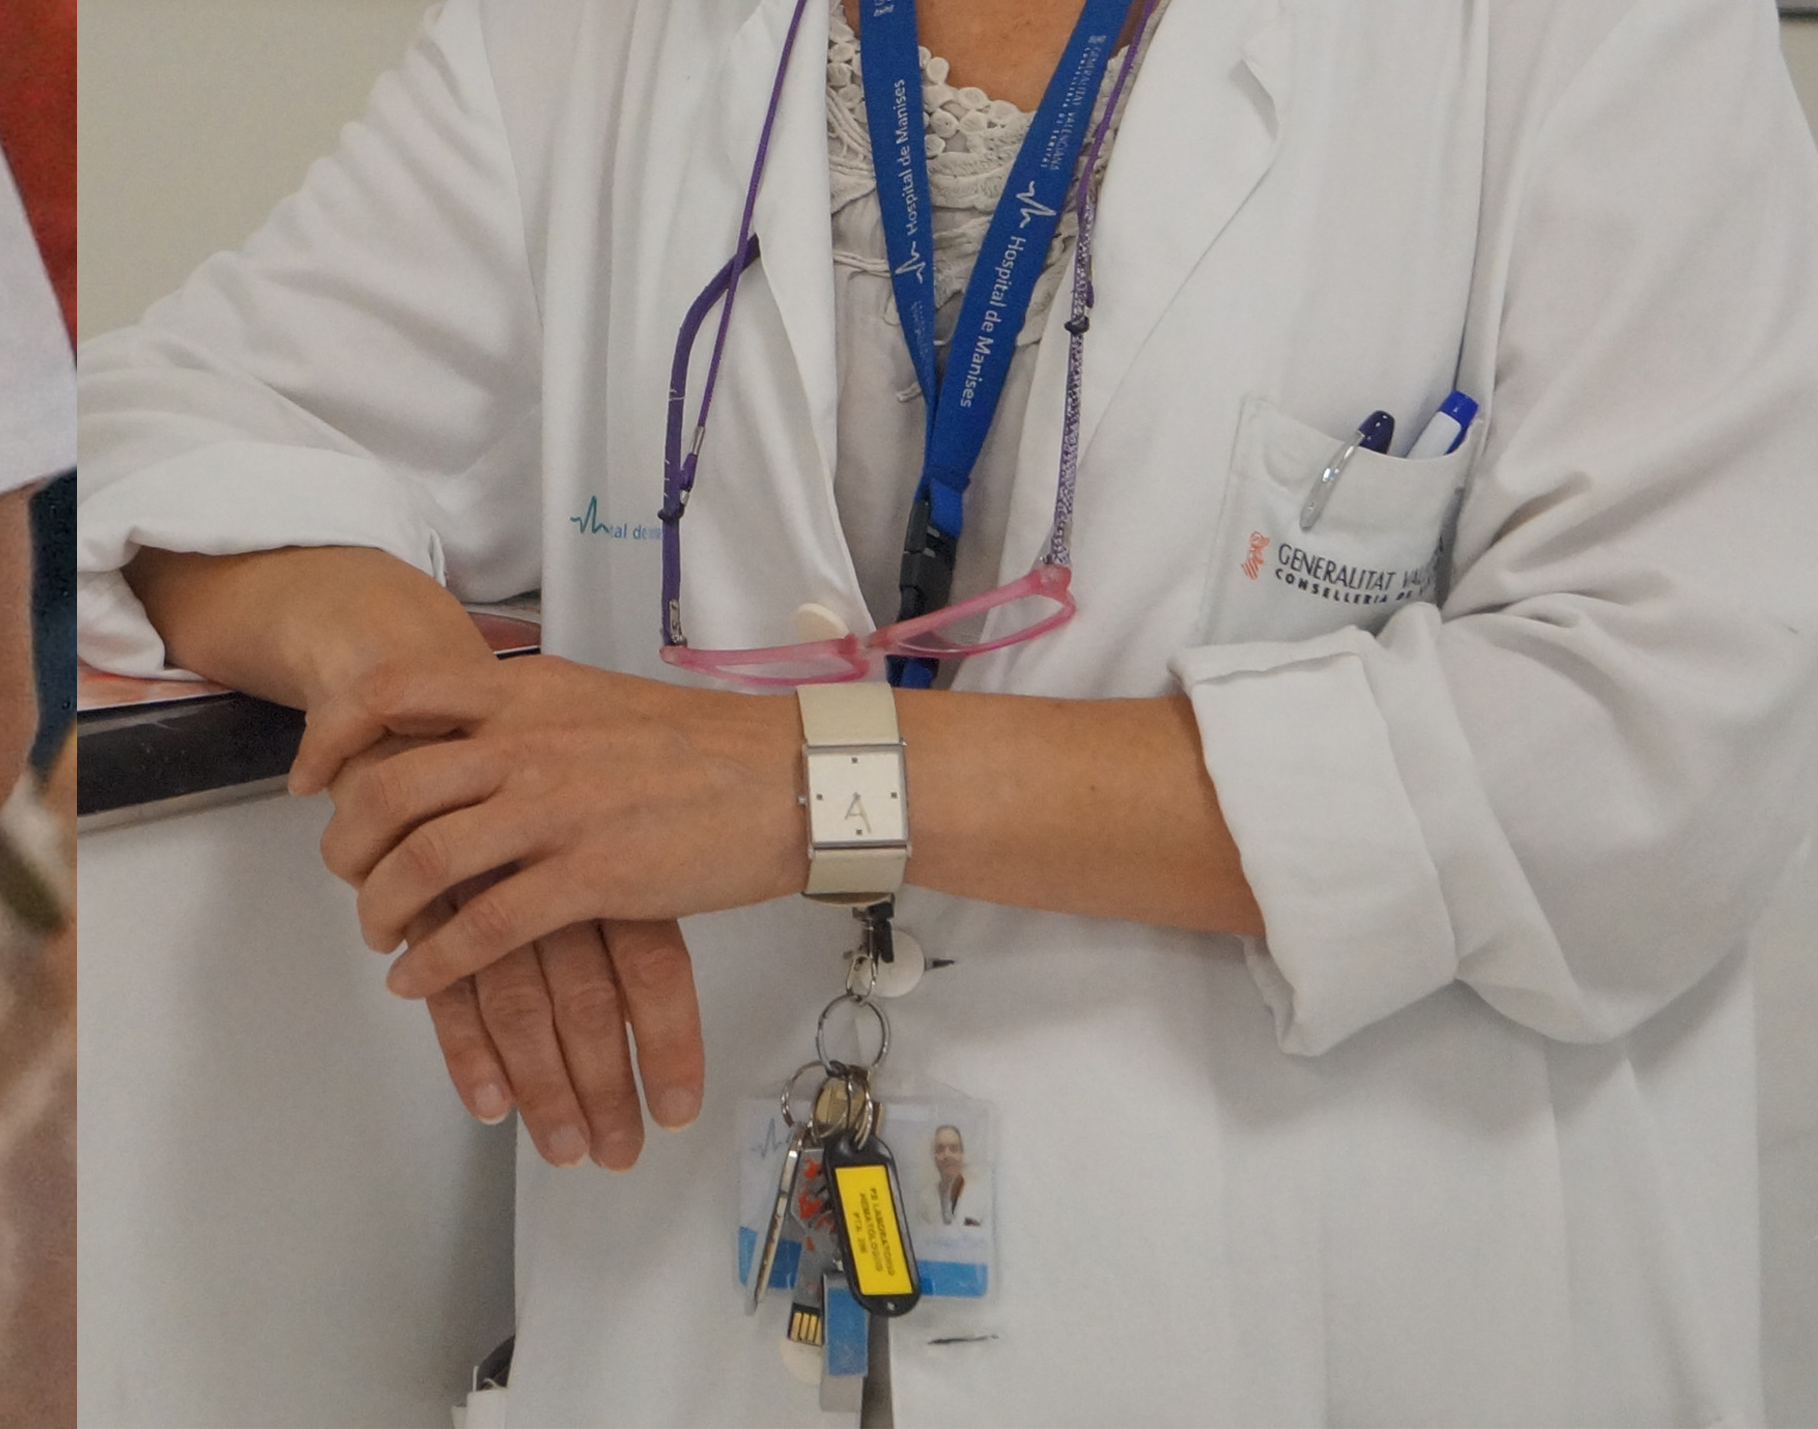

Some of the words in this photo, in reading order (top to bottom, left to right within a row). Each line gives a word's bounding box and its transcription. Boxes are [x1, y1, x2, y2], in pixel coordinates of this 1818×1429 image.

[893, 78, 909, 145] Manises
[896, 145, 911, 167] de
[897, 168, 918, 236] Hospital
[989, 235, 1027, 308] Hospital
[981, 310, 1002, 332] de
[960, 335, 994, 408] Manises
[1276, 568, 1387, 604] CONSELLERIA
[1278, 543, 1396, 591] GENERALITAT
